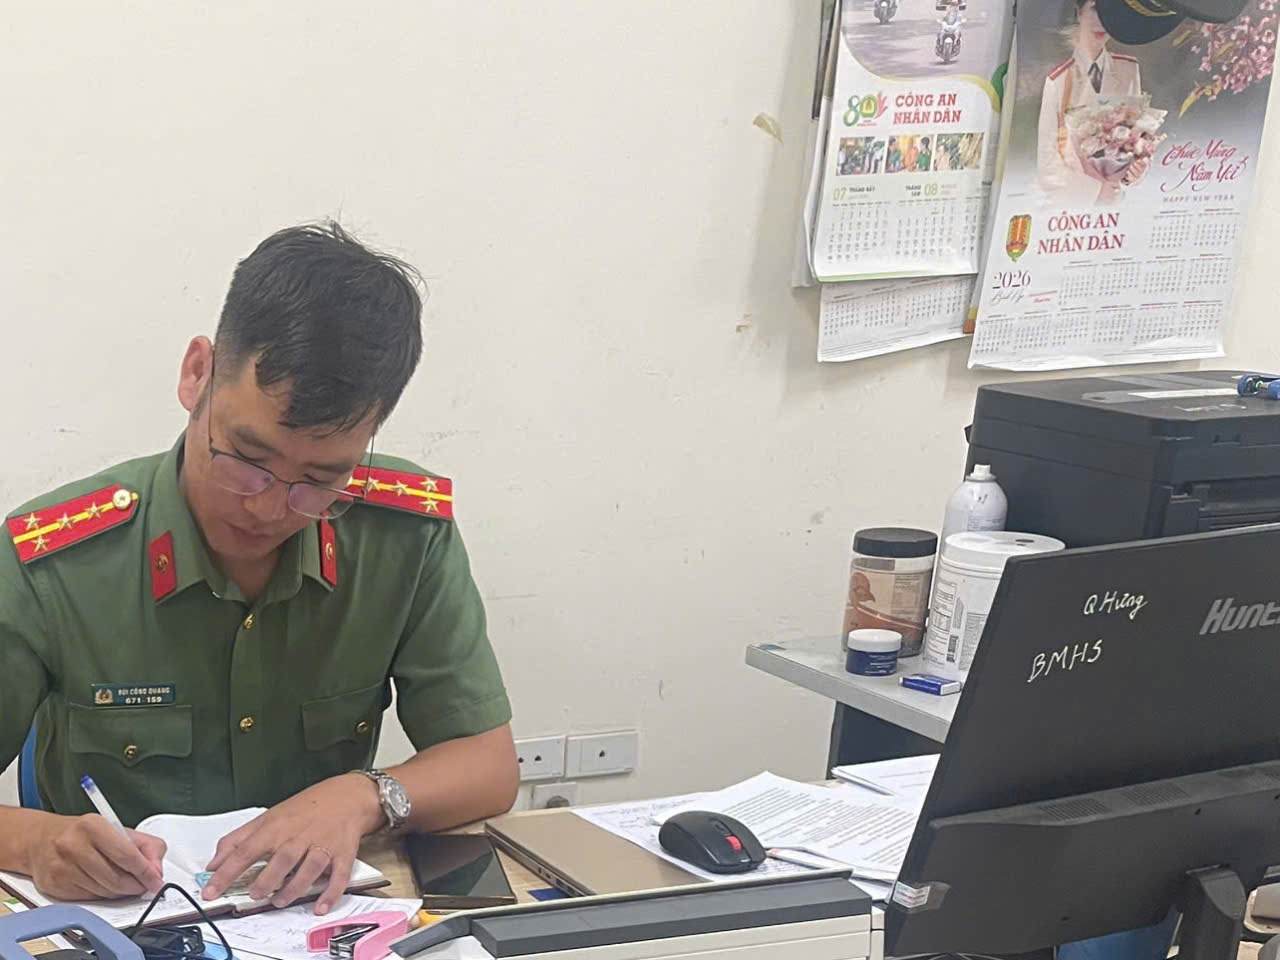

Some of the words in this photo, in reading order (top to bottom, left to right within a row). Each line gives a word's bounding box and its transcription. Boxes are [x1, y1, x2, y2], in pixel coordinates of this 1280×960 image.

[895, 92, 934, 108] CÔNG
[937, 93, 958, 106] AN
[893, 110, 931, 125] NHÂN
[933, 108, 962, 124] DÂN
[1048, 211, 1091, 232] CÔNG
[1093, 213, 1120, 228] AN
[1037, 232, 1084, 255] NHÂN
[1087, 230, 1126, 250] DÂN
[992, 271, 1031, 290] 2026
[1027, 639, 1103, 683] BMHS
